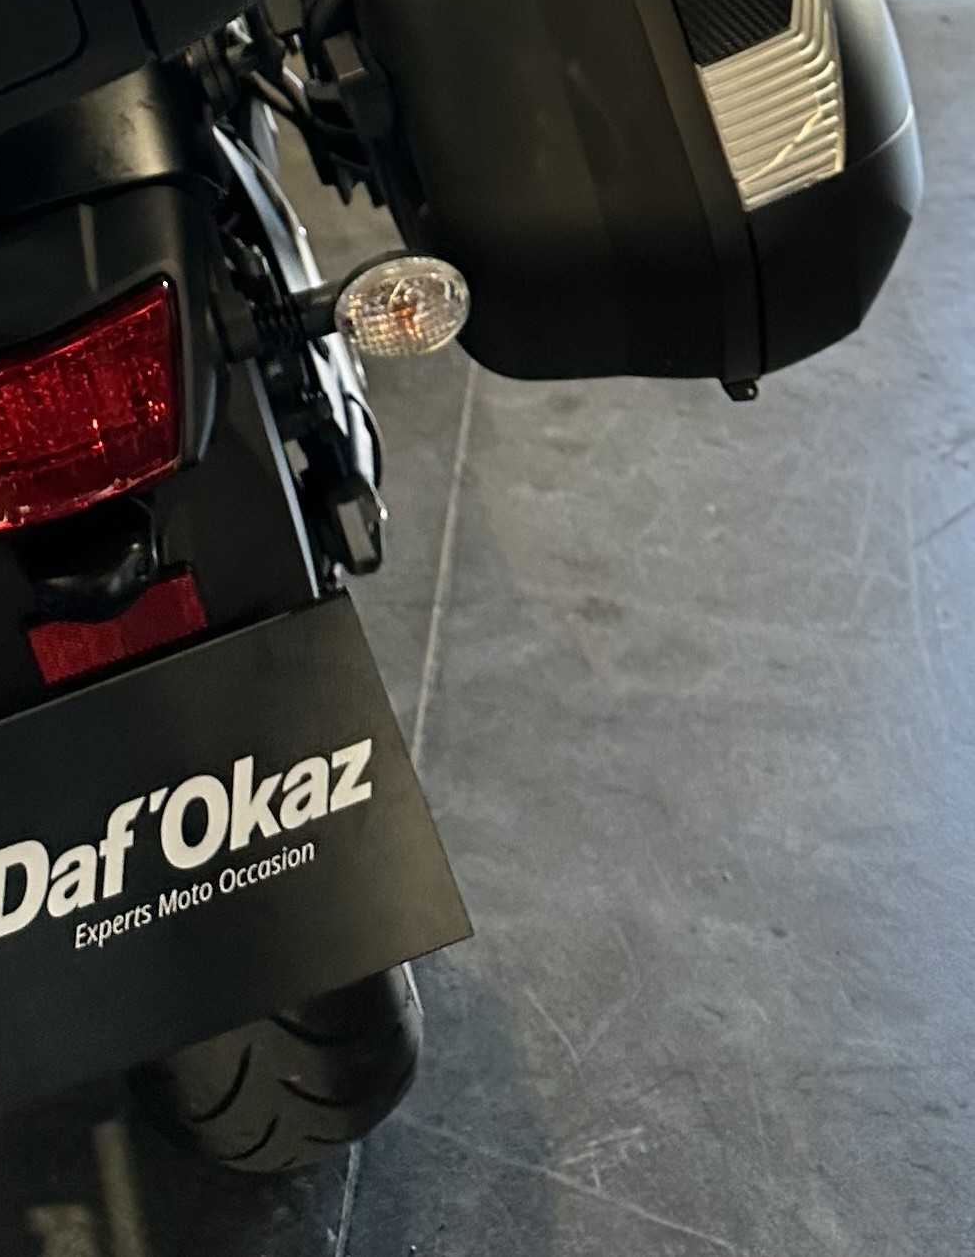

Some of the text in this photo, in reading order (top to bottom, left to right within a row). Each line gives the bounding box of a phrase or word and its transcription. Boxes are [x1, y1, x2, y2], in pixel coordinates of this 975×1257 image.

[74, 841, 316, 950] Experts Moto Occasion
